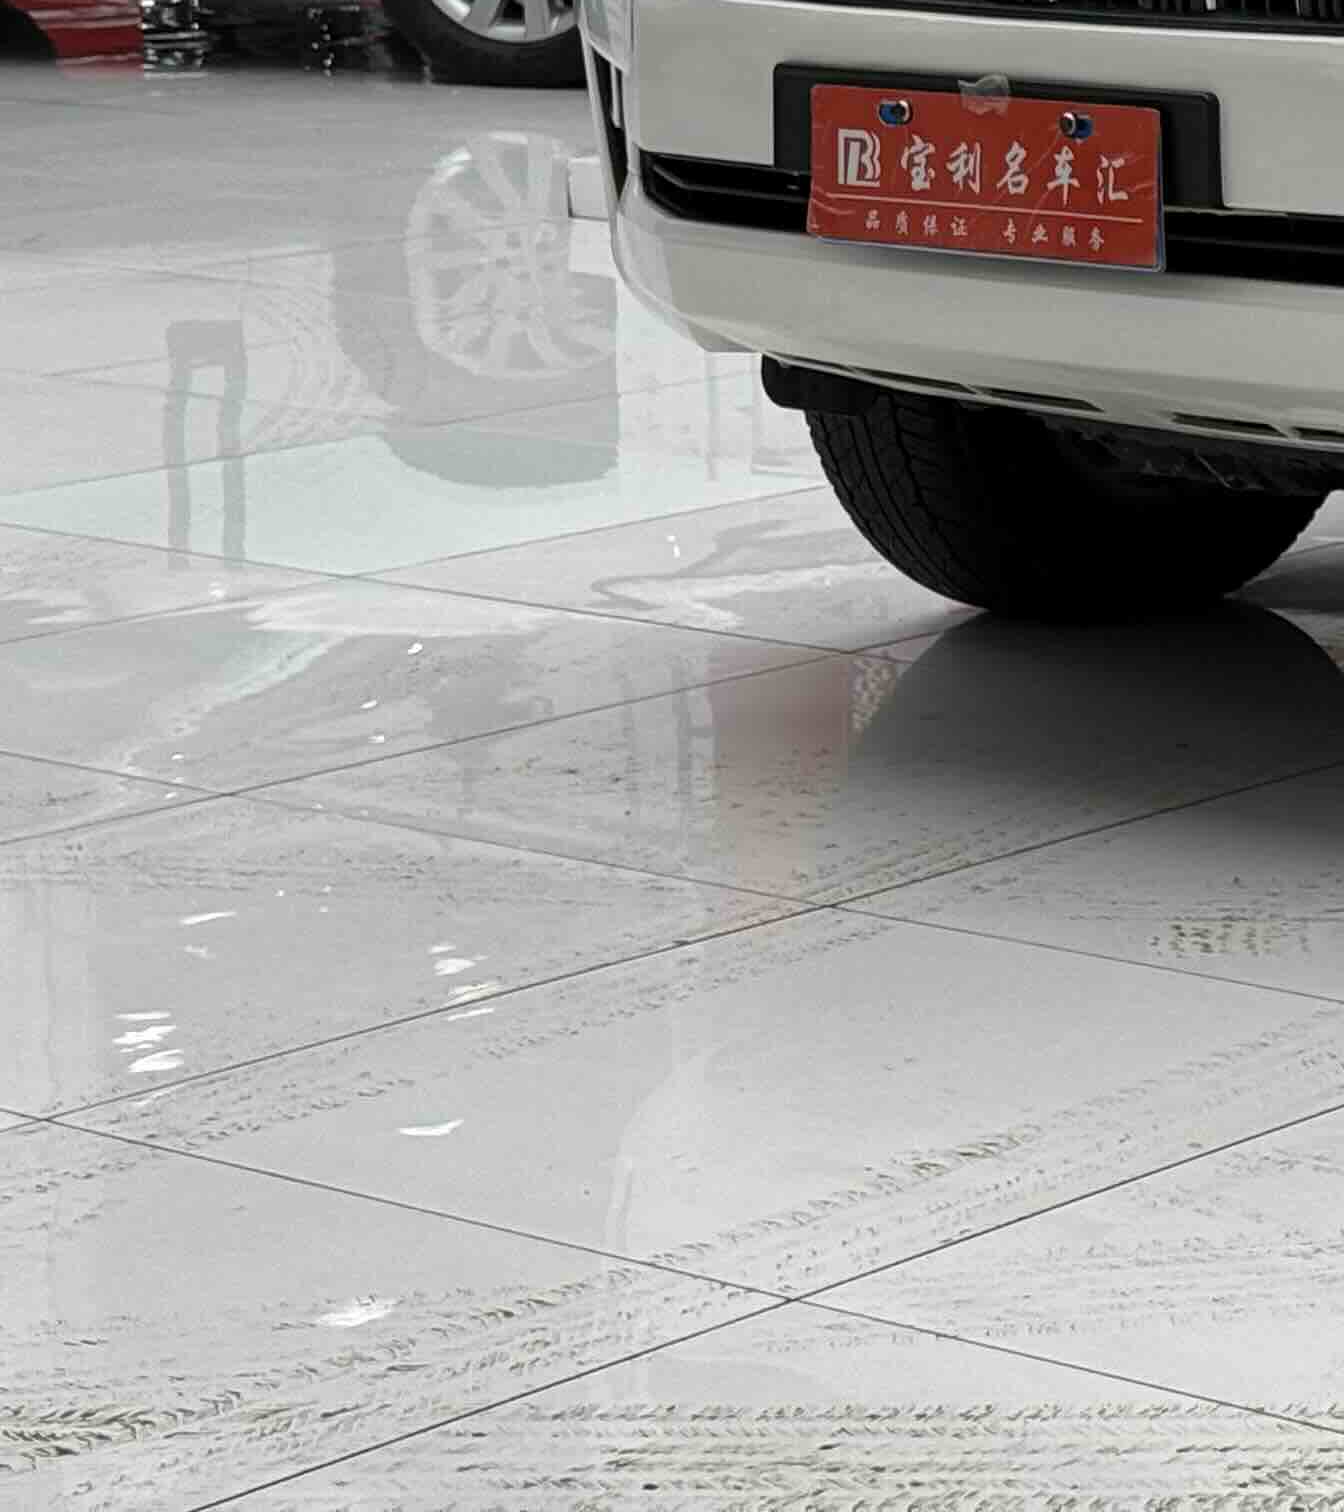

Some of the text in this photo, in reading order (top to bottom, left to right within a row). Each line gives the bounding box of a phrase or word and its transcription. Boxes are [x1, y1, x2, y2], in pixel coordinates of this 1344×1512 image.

[900, 132, 1131, 206] 宝利名车汇
[863, 208, 1105, 252] 品质保证 专业服务
